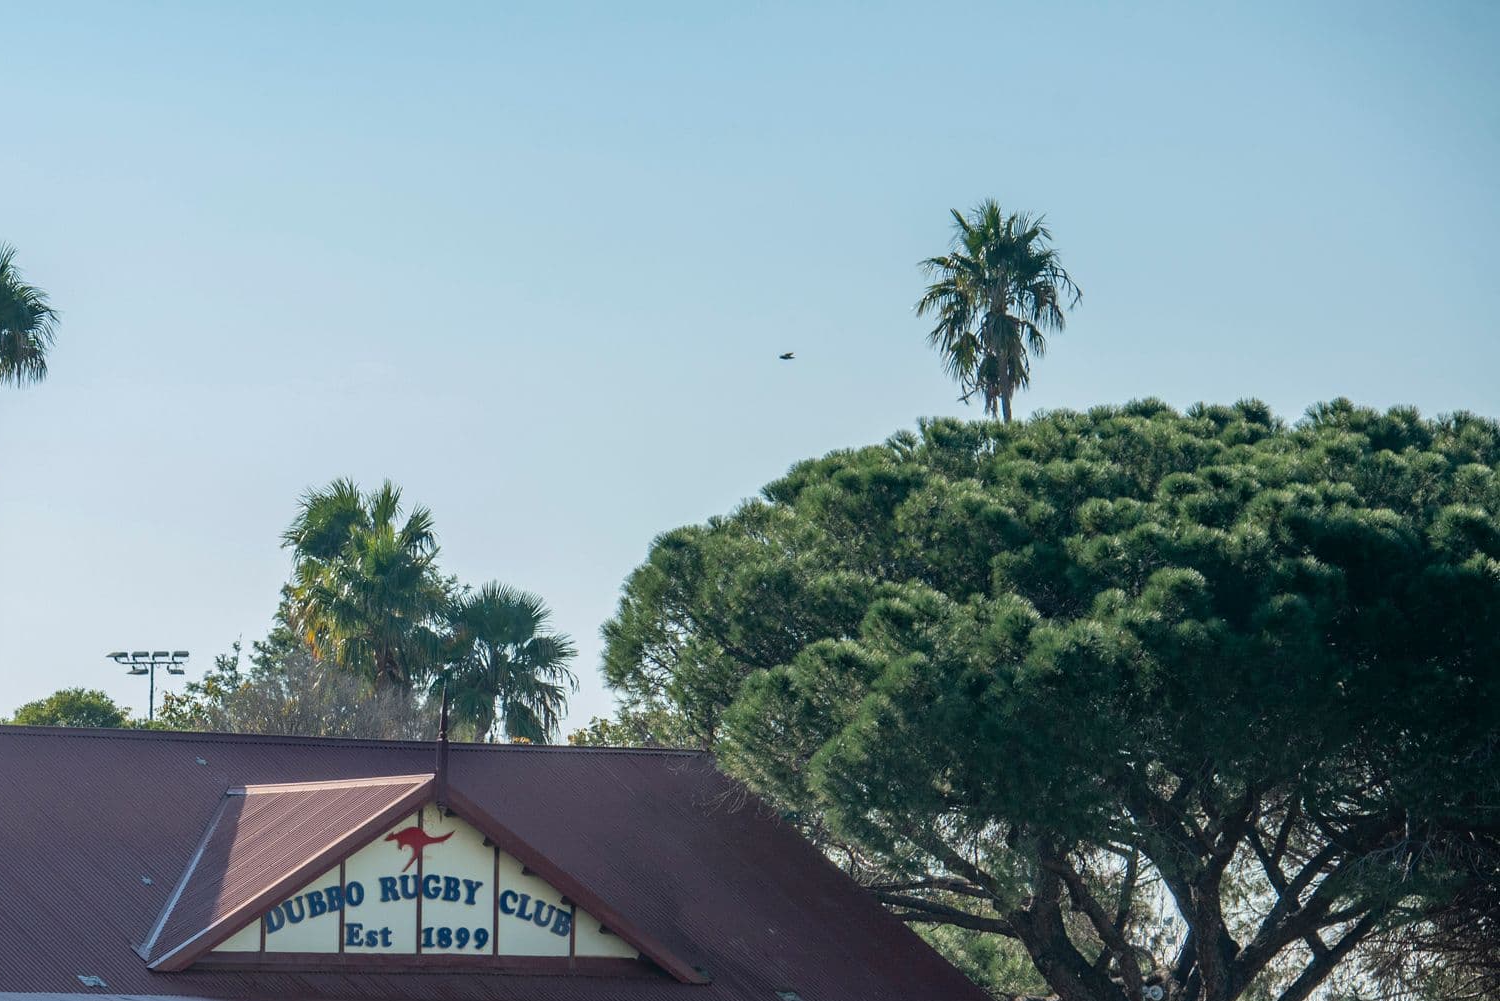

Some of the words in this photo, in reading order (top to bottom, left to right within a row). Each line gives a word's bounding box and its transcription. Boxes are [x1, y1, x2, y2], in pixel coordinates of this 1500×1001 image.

[264, 881, 364, 935] DUBBO
[378, 873, 483, 906] RUGBY
[500, 889, 572, 938] CLUB
[345, 922, 393, 948] Est
[422, 926, 490, 950] 1899
